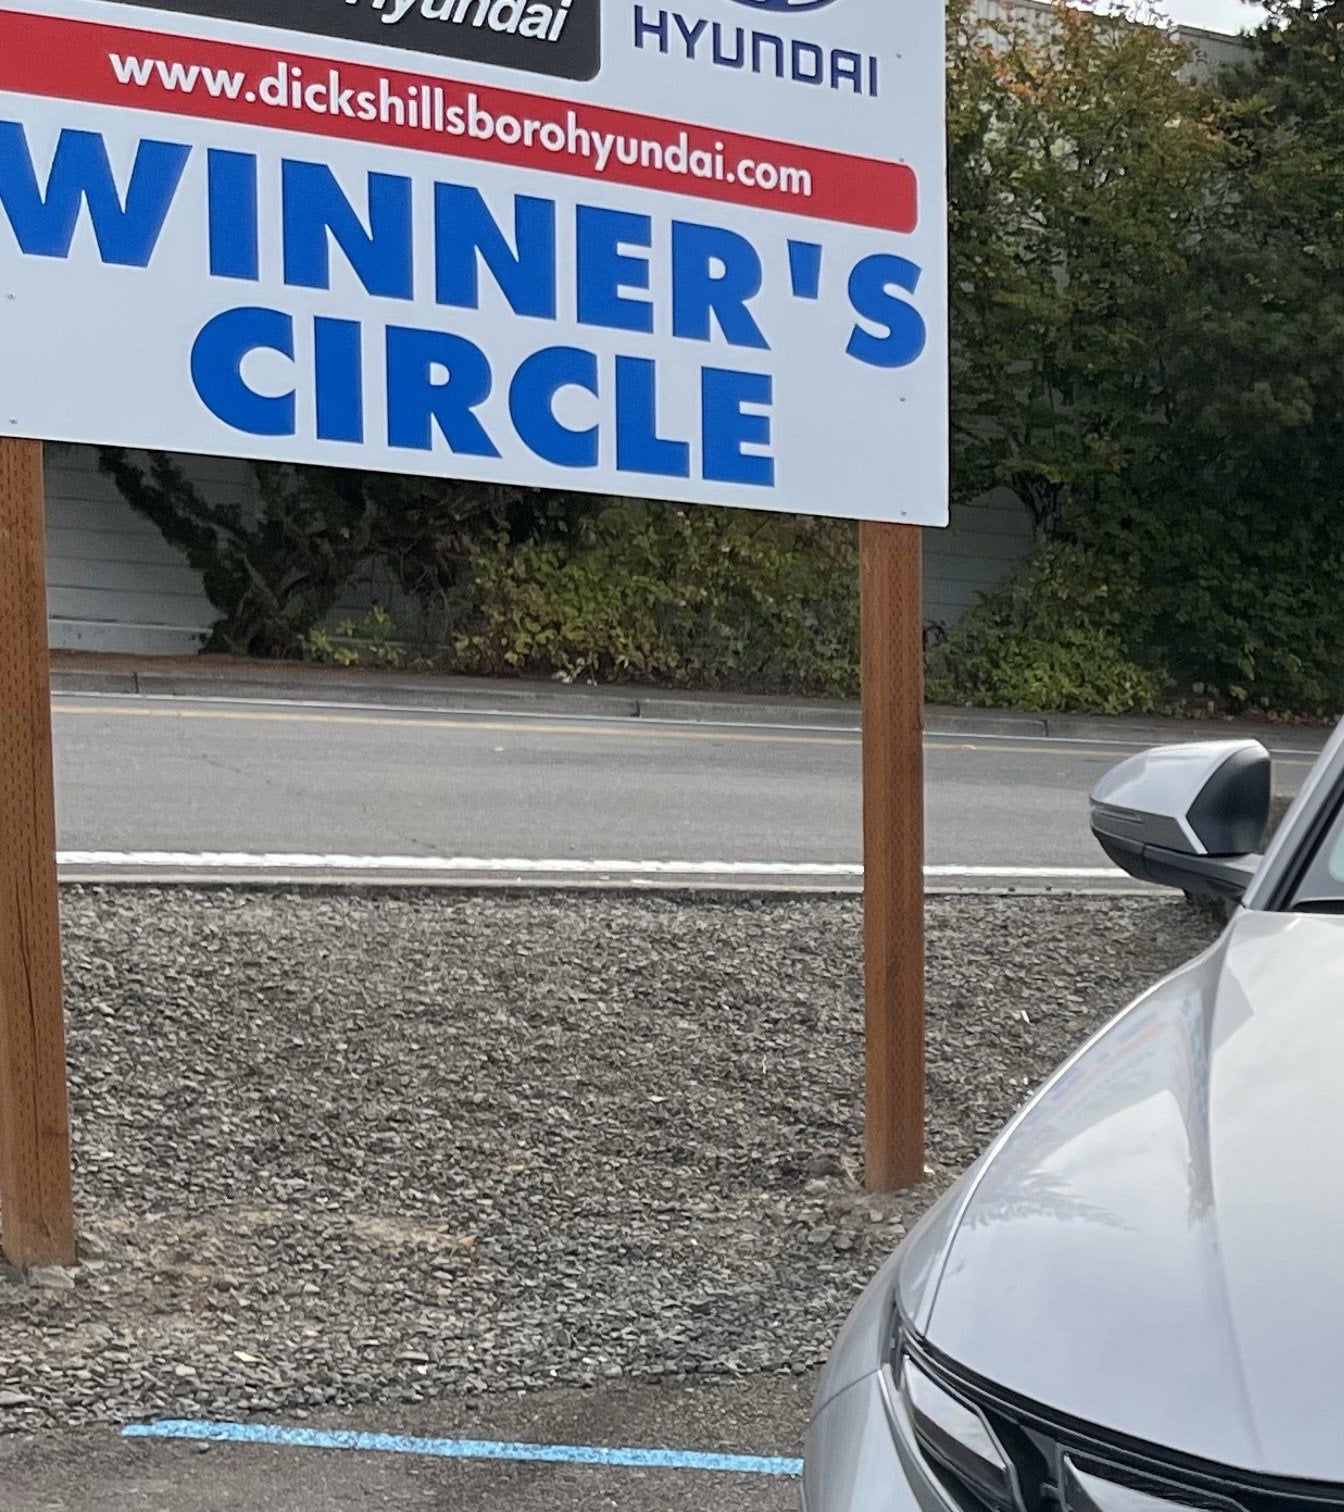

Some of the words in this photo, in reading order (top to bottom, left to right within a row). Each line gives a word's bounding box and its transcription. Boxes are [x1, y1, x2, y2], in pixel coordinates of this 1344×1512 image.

[108, 50, 814, 197] www.dickshillsborohyundai.com
[633, 4, 878, 98] HYUNDAI
[0, 120, 926, 369] WINNER'S
[190, 305, 776, 488] CIRCLE
